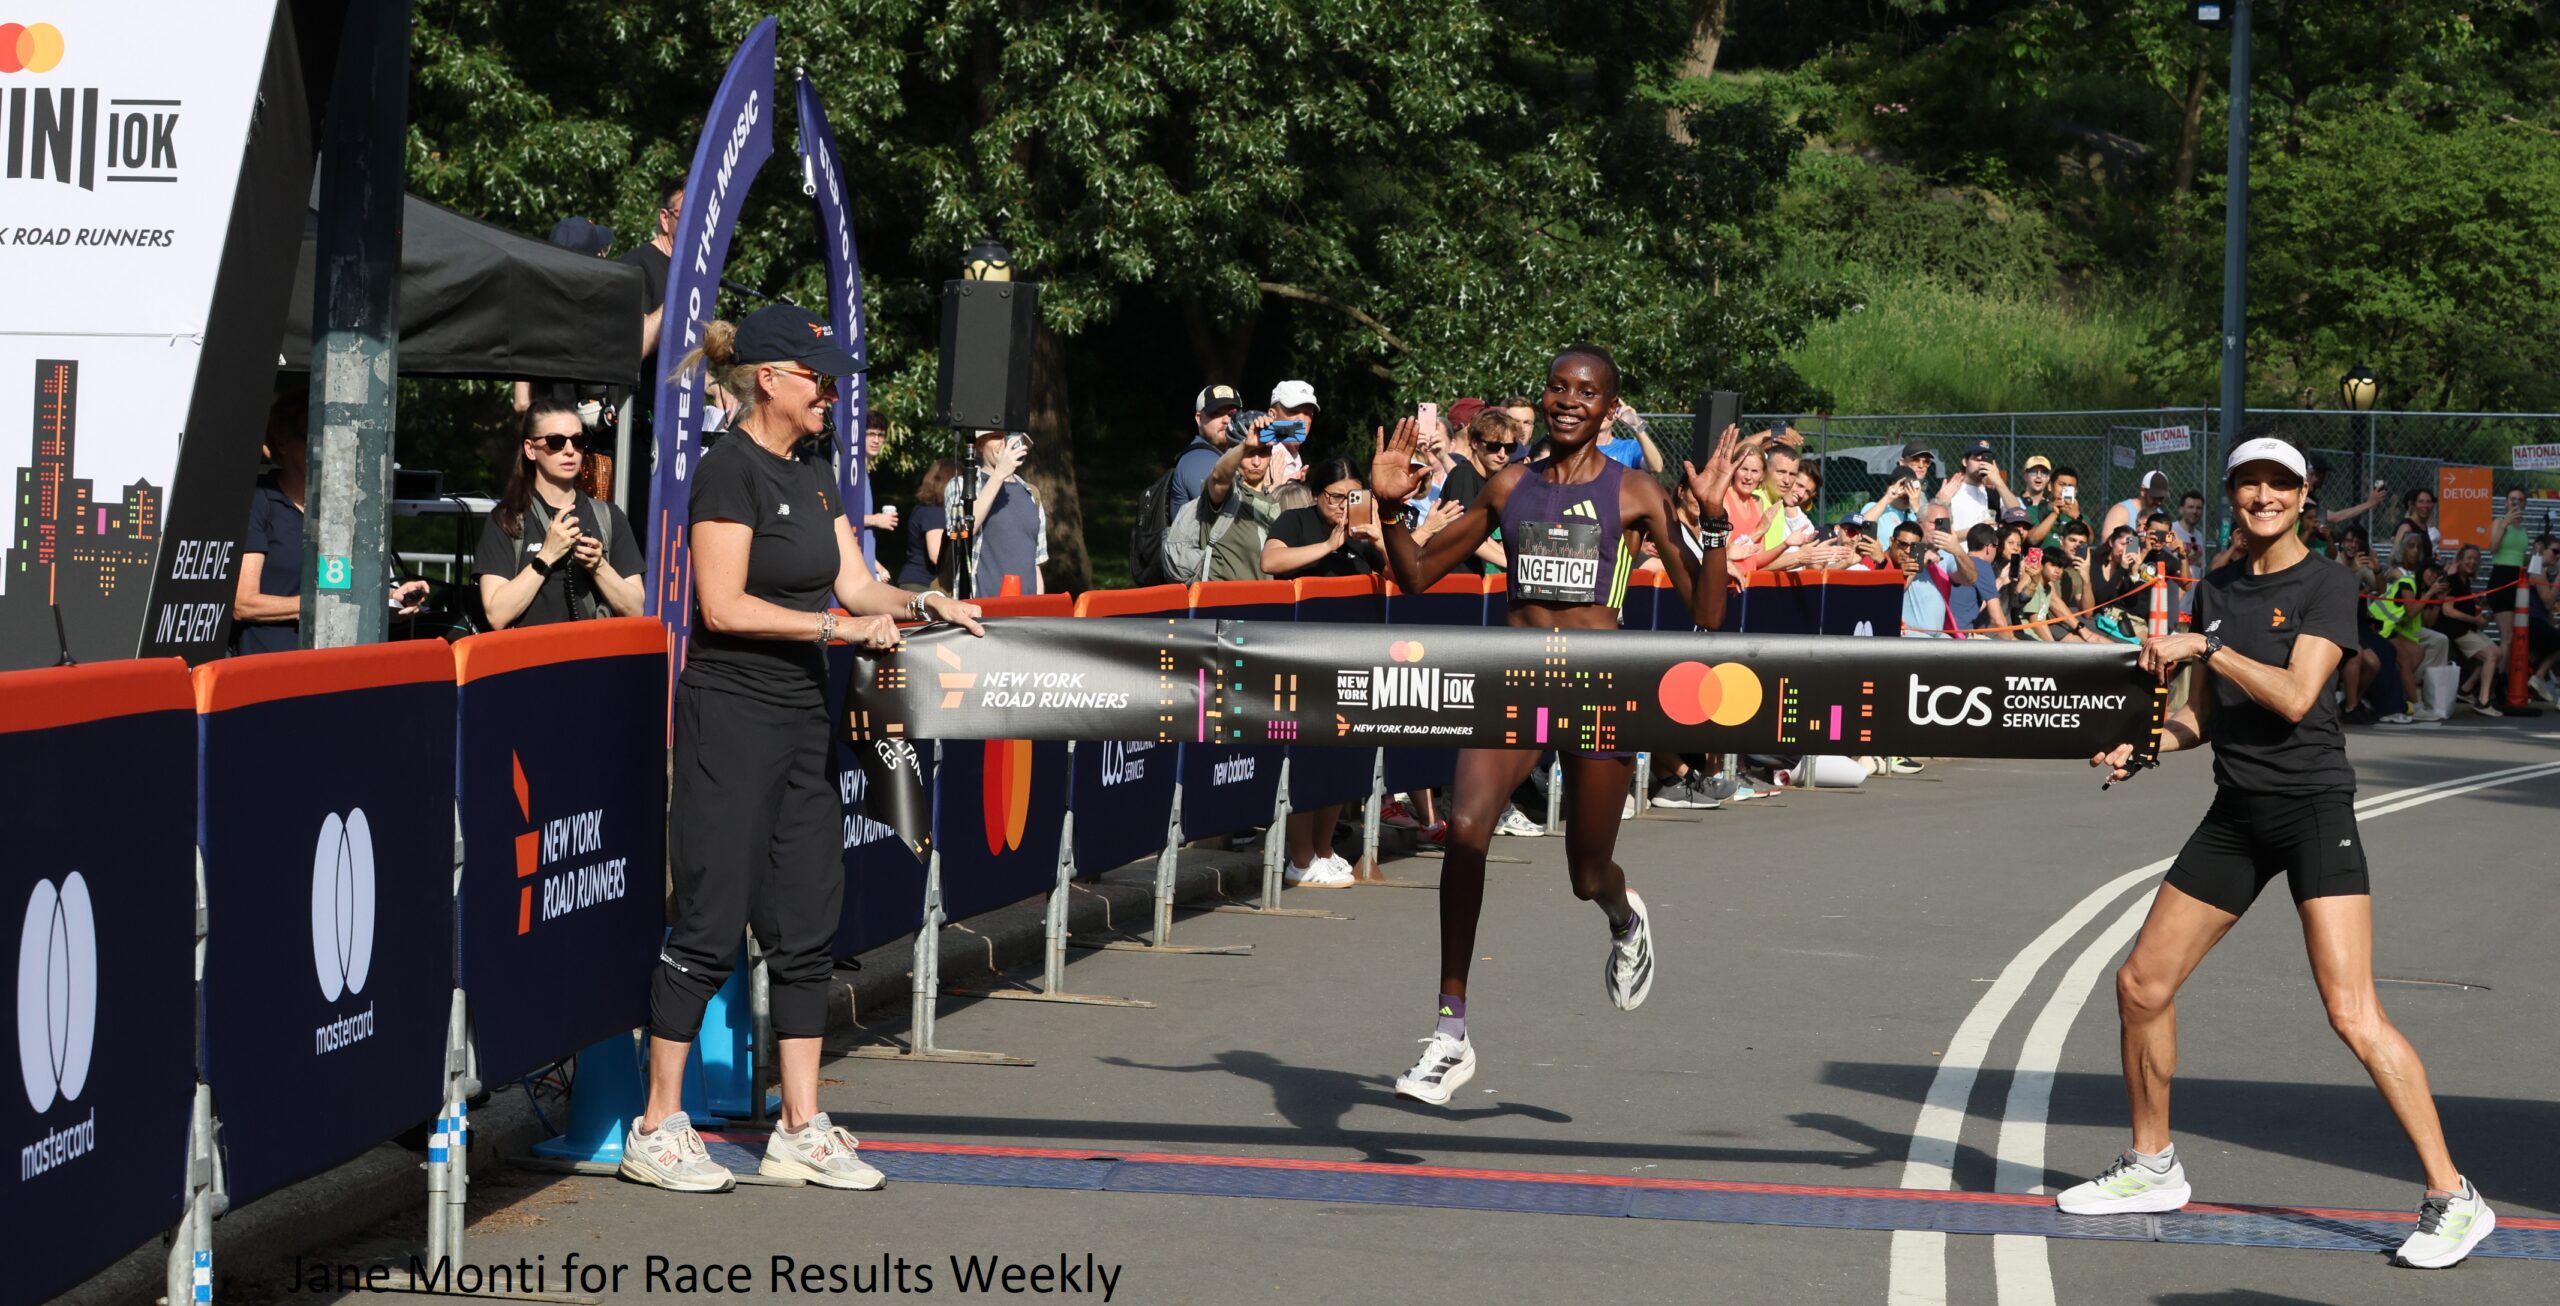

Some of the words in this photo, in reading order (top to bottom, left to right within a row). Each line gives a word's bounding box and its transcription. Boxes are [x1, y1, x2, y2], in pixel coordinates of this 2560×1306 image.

[0, 88, 99, 192] INI
[107, 112, 180, 169] 10K
[12, 227, 71, 246] ROAD
[75, 228, 175, 248] RUNNERS
[819, 136, 840, 206] STEP
[839, 203, 849, 261] TO
[846, 262, 858, 346] THE
[675, 363, 693, 482] STEP
[684, 286, 701, 347] TO
[695, 189, 721, 276] THE
[716, 89, 759, 200] MUSIC
[2143, 428, 2188, 443] NATIONAL
[2443, 488, 2489, 499] DETOUR
[172, 540, 235, 580] BELIEVE
[326, 559, 344, 584] 8
[1519, 557, 1595, 585] NGETICH
[155, 603, 179, 643] IN
[174, 603, 226, 643] EVERY
[982, 671, 1030, 688] NEW
[1033, 672, 1086, 689] YORK
[1337, 675, 1369, 689] NEW
[1337, 689, 1368, 701] YORK
[1371, 666, 1441, 713] MINI
[1443, 678, 1475, 704] 10K
[2005, 676, 2058, 691] TATA
[981, 691, 1036, 708] ROAD
[1039, 691, 1130, 709] RUNNERS
[1908, 673, 1993, 727] tcs
[2003, 695, 2127, 710] CONSULTANCY
[1353, 724, 1376, 733] NEW
[1376, 724, 1402, 734] YORK
[1403, 724, 1430, 735] ROAD
[1430, 725, 1474, 736] RUNNERS
[2002, 713, 2081, 728] SERVICES
[1213, 761, 1229, 787] new
[1227, 752, 1256, 785] balance
[542, 816, 572, 865] NEW
[572, 808, 604, 857] YORK
[843, 813, 864, 850] OAD
[542, 871, 576, 922] ROAD
[576, 856, 627, 910] RUNNERS
[315, 999, 374, 1057] mastercard
[21, 1106, 95, 1182] mastercard
